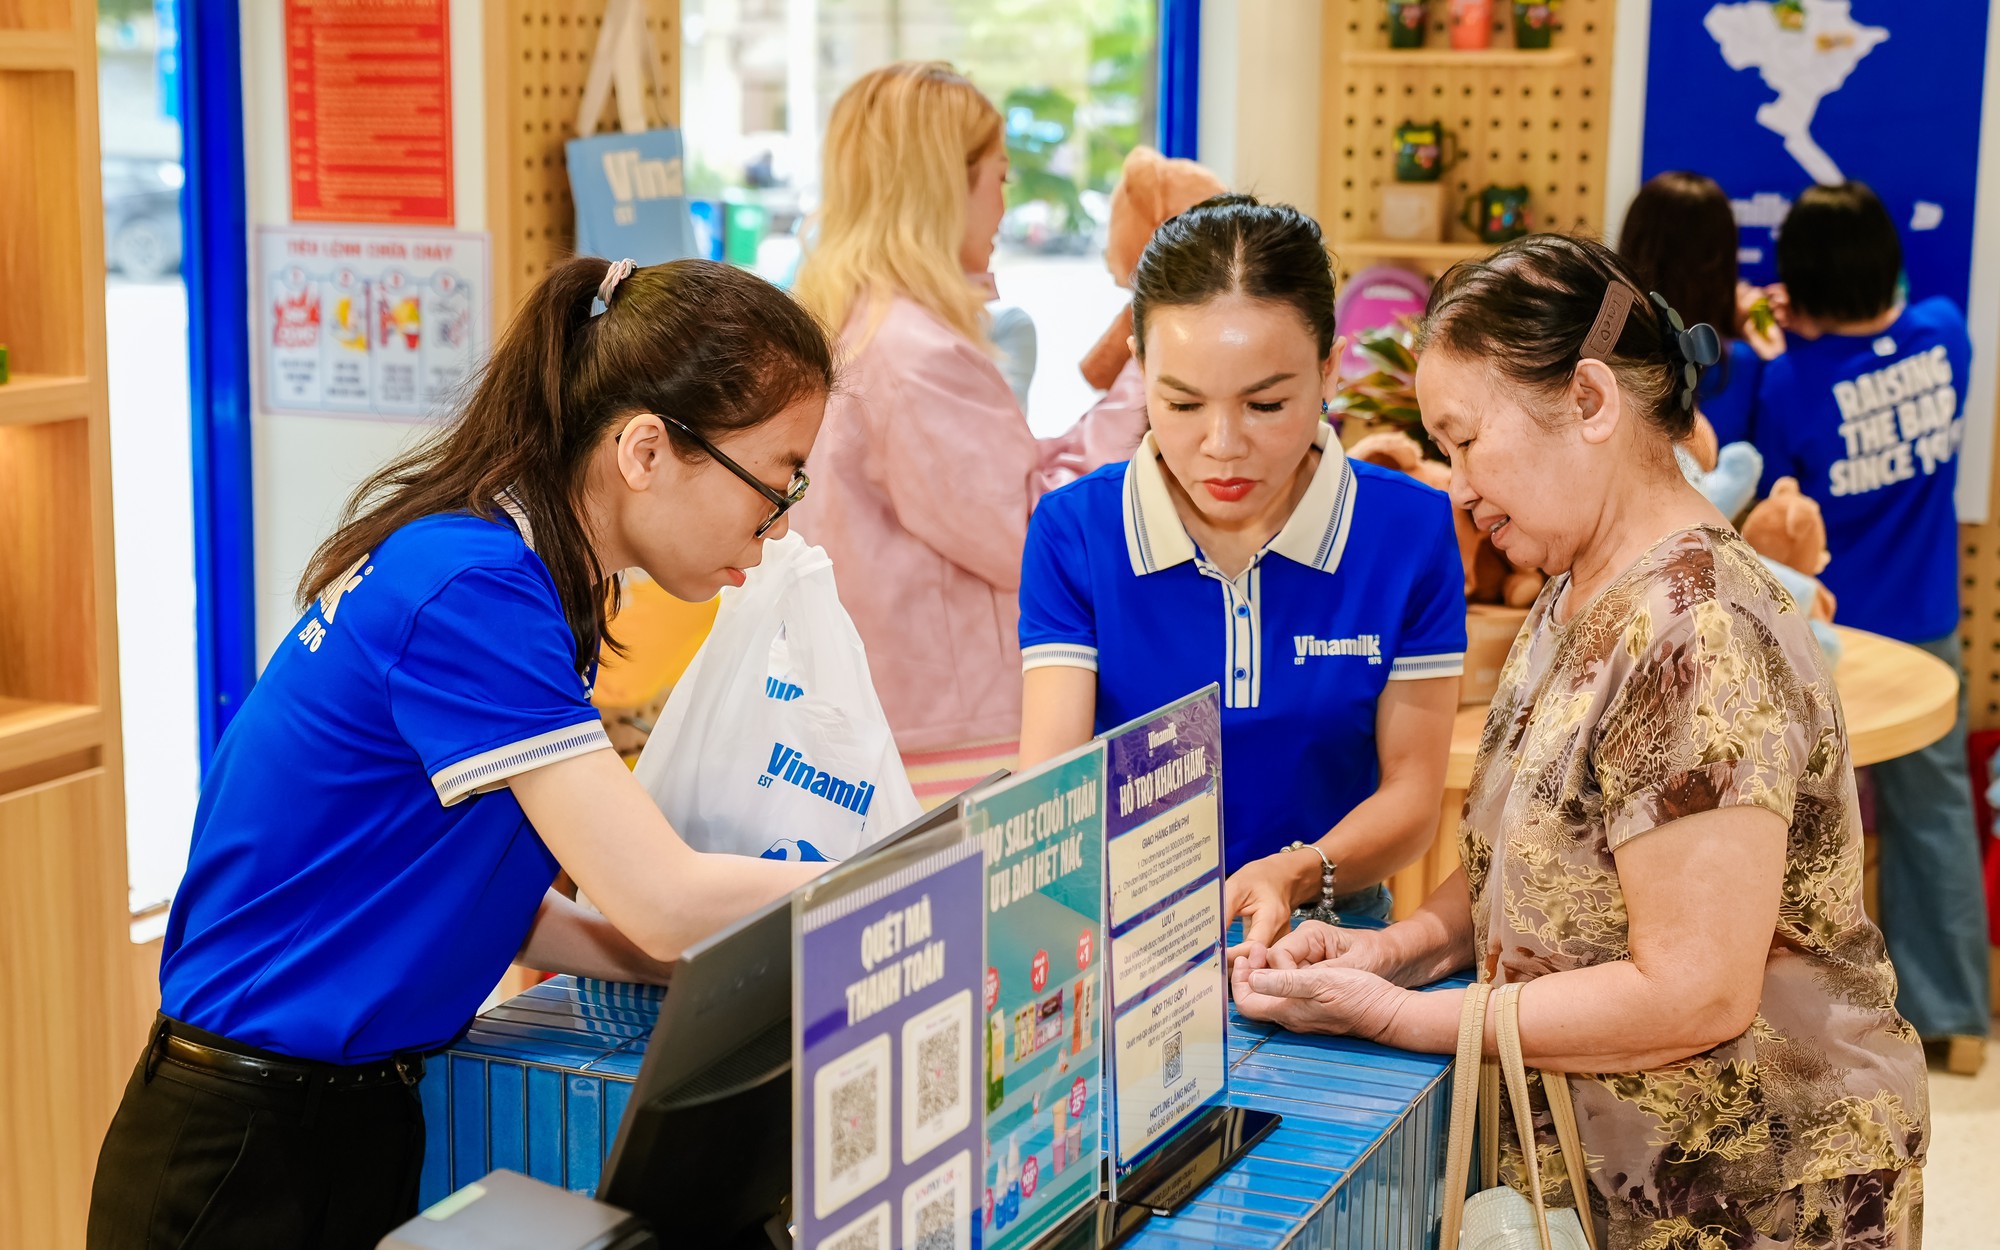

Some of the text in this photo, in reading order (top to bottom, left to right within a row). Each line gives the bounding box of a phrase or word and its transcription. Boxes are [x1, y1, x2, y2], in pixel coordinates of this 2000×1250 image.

[1832, 345, 1953, 421] RAISING
[1838, 409, 1900, 458] THE
[1829, 441, 1916, 497] SINCE
[1293, 635, 1381, 656] Vinamilk
[1148, 722, 1177, 750] Vinamilk
[757, 774, 774, 789] EST
[1119, 746, 1207, 818] HỖ TRỢ KHÁCH HÀNG
[1005, 808, 1035, 857] SALE
[1142, 834, 1154, 850] GIAO
[861, 911, 904, 971] QUÉT
[846, 961, 902, 1027] THANH
[903, 939, 946, 997] TOÁN
[1150, 1097, 1170, 1121] HOTLINE
